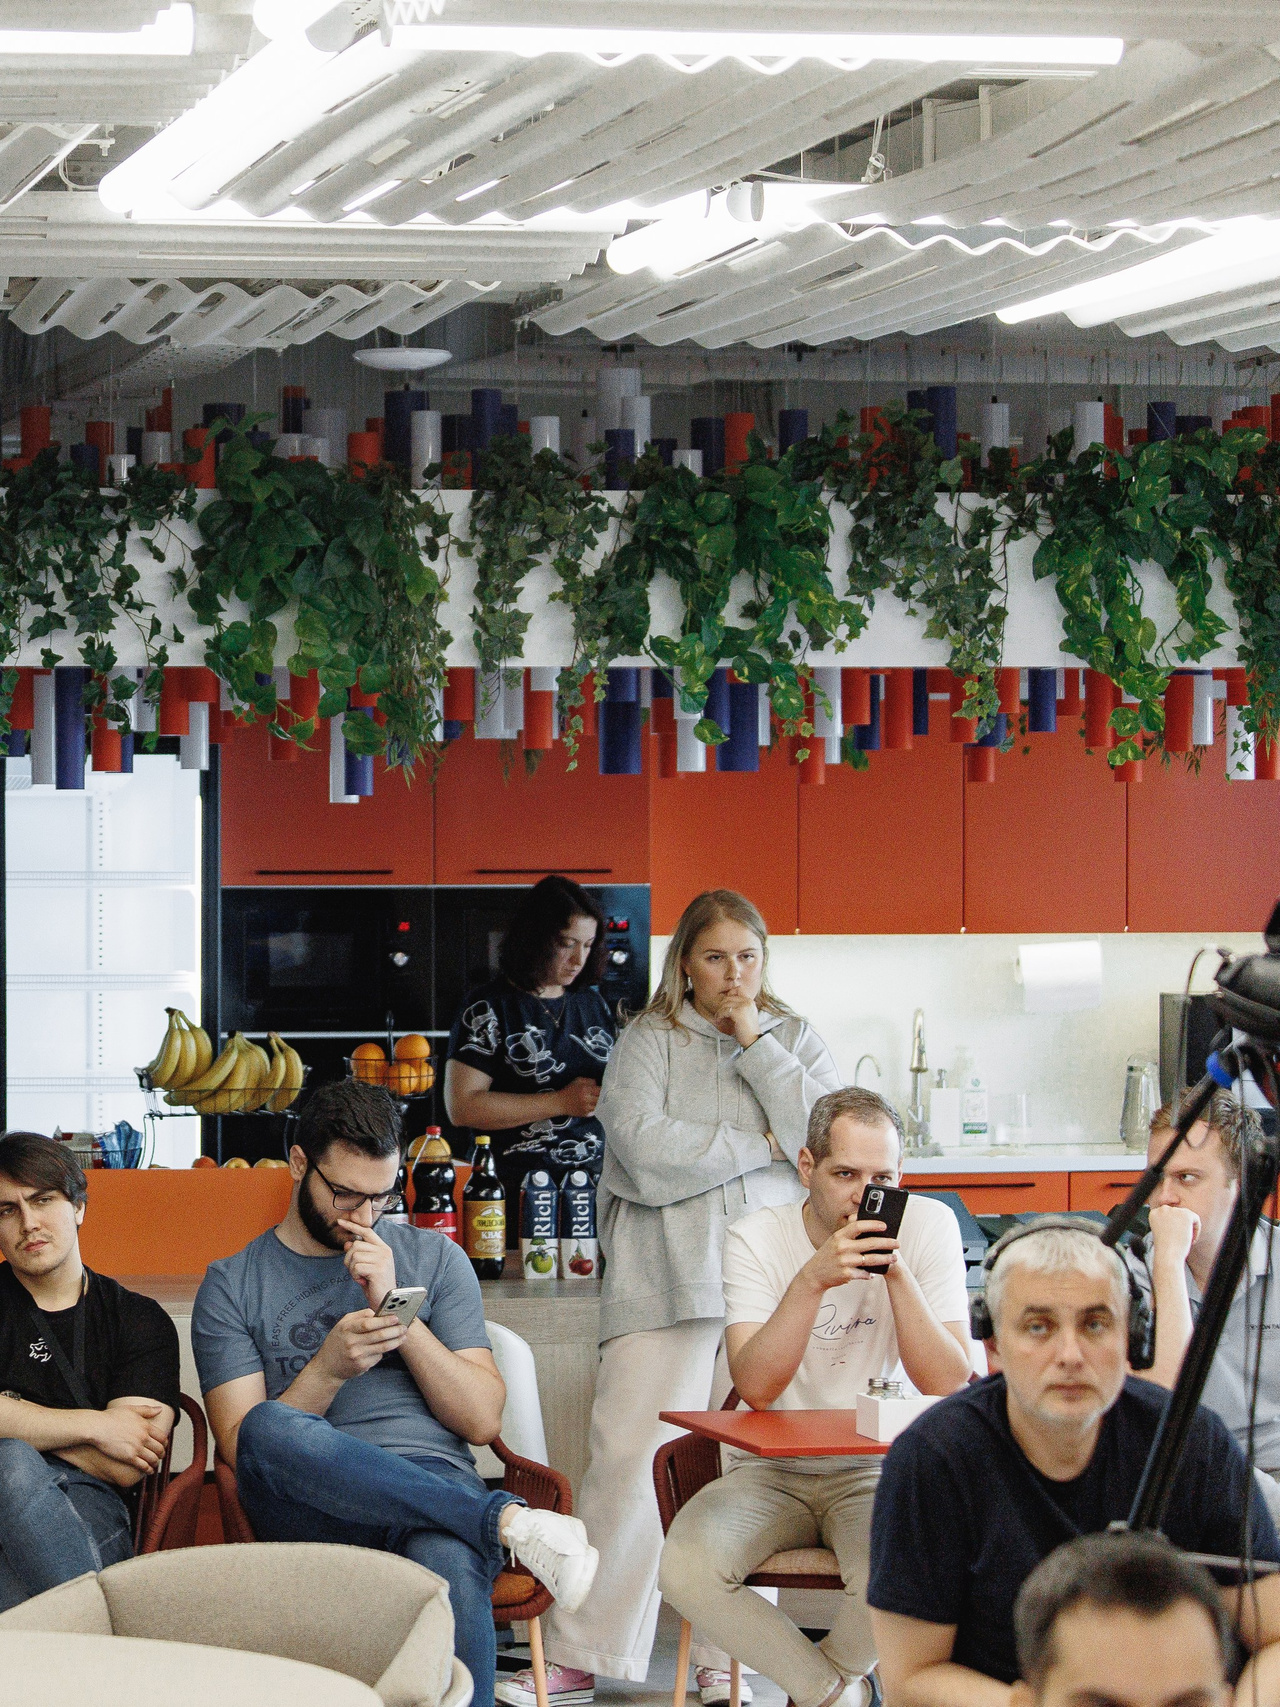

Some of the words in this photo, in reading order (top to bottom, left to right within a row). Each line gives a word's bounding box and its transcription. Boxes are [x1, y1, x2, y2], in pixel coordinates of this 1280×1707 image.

[533, 1191, 552, 1237] Rich
[571, 1192, 590, 1237] Rich
[294, 1280, 329, 1303] RIDING
[276, 1299, 297, 1323] FREE
[271, 1322, 282, 1347] EASY
[275, 1354, 315, 1377] TO
